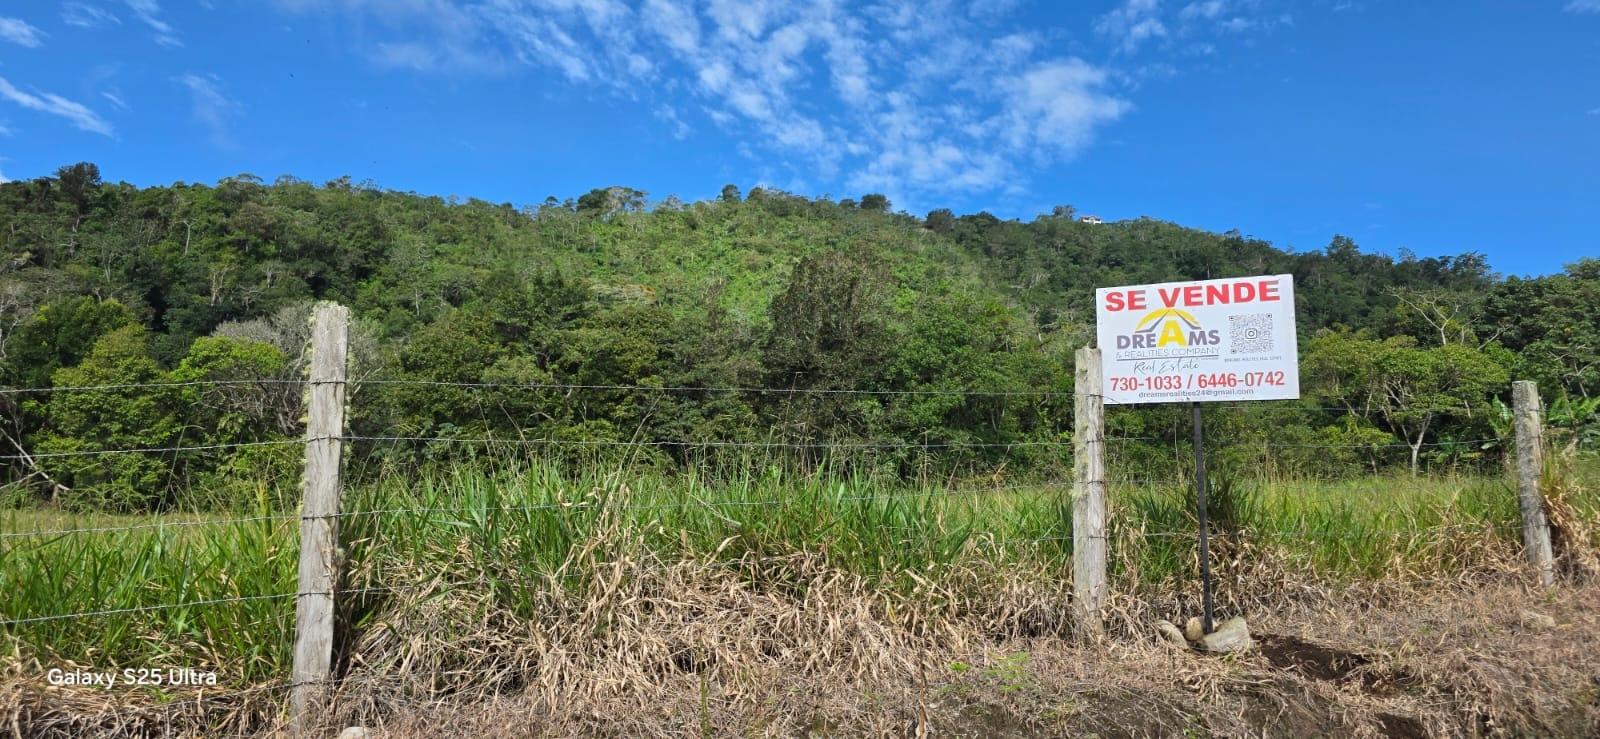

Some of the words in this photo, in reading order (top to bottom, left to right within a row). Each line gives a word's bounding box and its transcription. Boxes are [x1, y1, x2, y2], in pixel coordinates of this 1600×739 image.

[1105, 290, 1147, 312] SE
[1158, 280, 1281, 308] VENDE
[1116, 319, 1221, 350] DREAMS
[1125, 349, 1170, 359] REALITIES
[1172, 347, 1220, 356] COMPANY
[1134, 360, 1156, 375] Real
[1158, 359, 1200, 374] Estate
[1110, 375, 1182, 391] 730-1033
[1186, 374, 1193, 389] /
[1197, 371, 1285, 388] 6446-0742
[1138, 388, 1254, 399] dreamsrealities24@gmail.com
